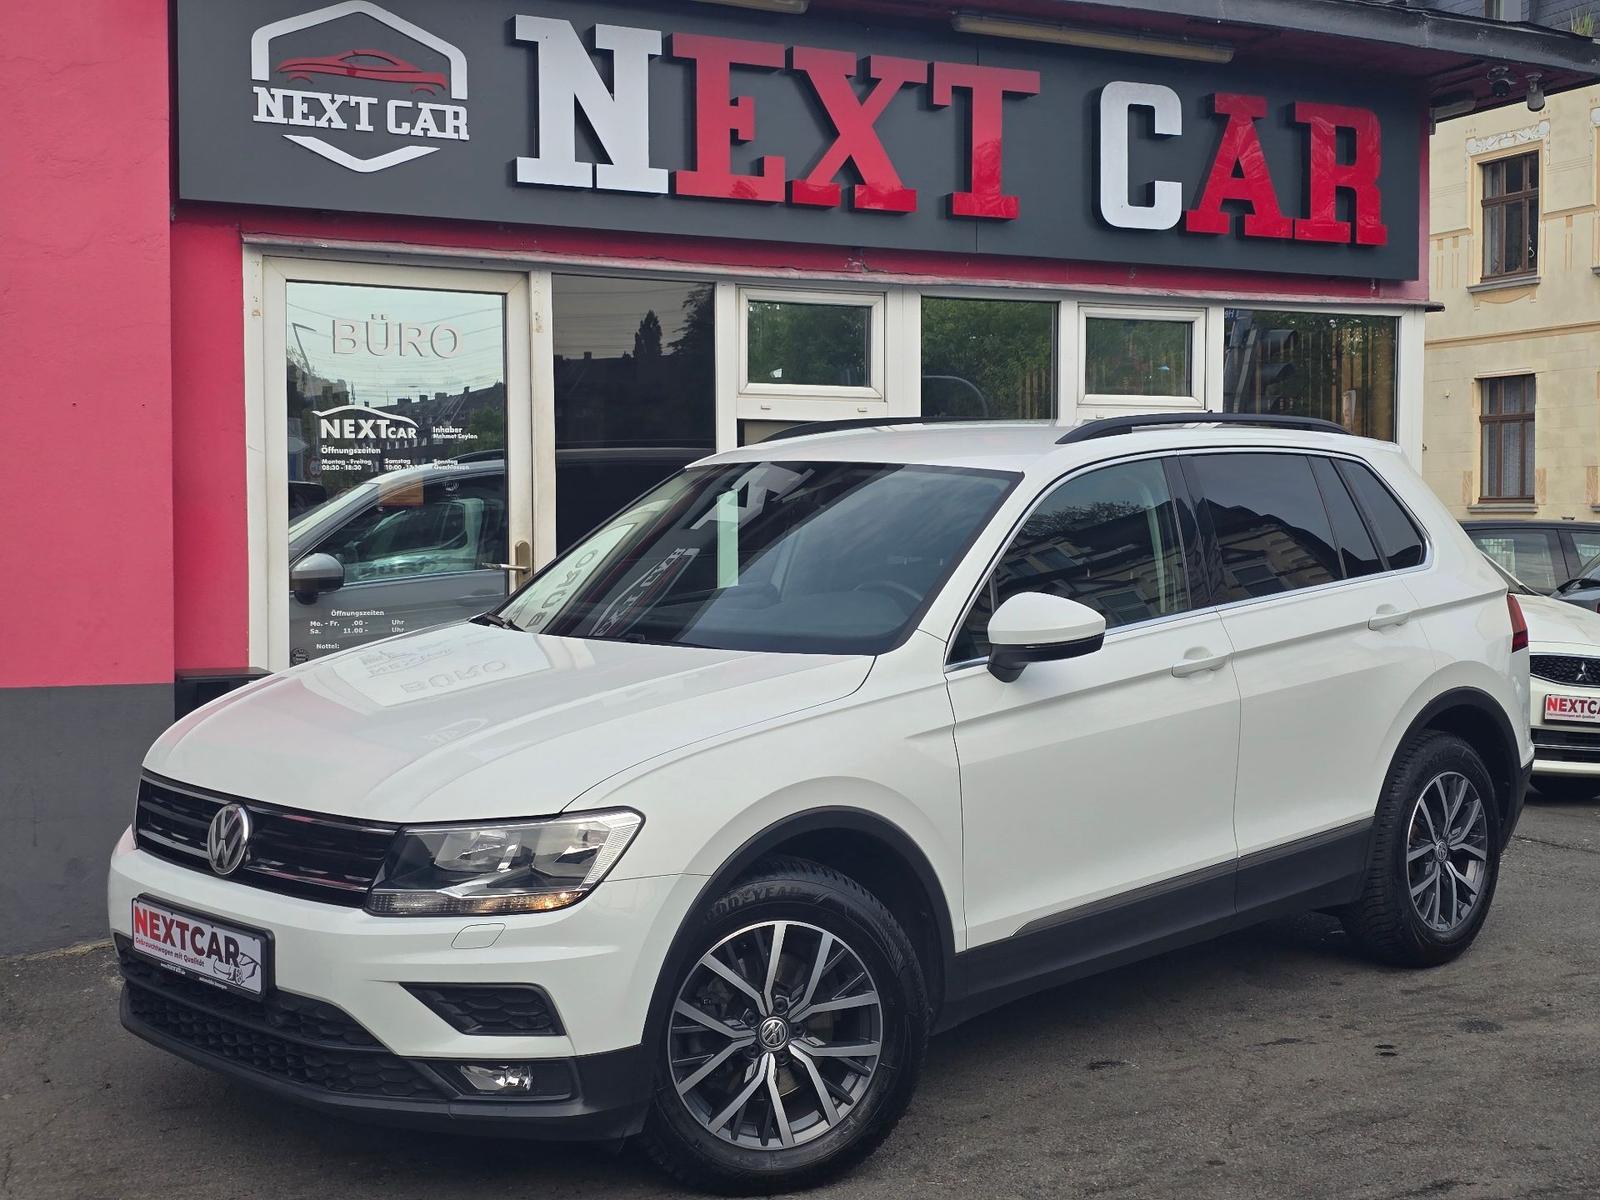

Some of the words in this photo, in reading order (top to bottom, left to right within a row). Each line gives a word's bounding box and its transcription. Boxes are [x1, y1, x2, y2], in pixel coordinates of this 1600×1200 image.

[252, 86, 378, 132] NEXT
[386, 99, 471, 141] CAR
[515, 14, 1041, 220] NEXT
[1099, 80, 1388, 246] CAR
[332, 313, 462, 359] BÜRO
[432, 426, 463, 434] Inhaber
[321, 446, 381, 455] Öffnungszeiten
[350, 458, 372, 466] Freitag
[331, 609, 384, 618] Öffnungszeiten
[1547, 696, 1600, 715] NEXTC
[134, 905, 241, 968] NEXTCAR
